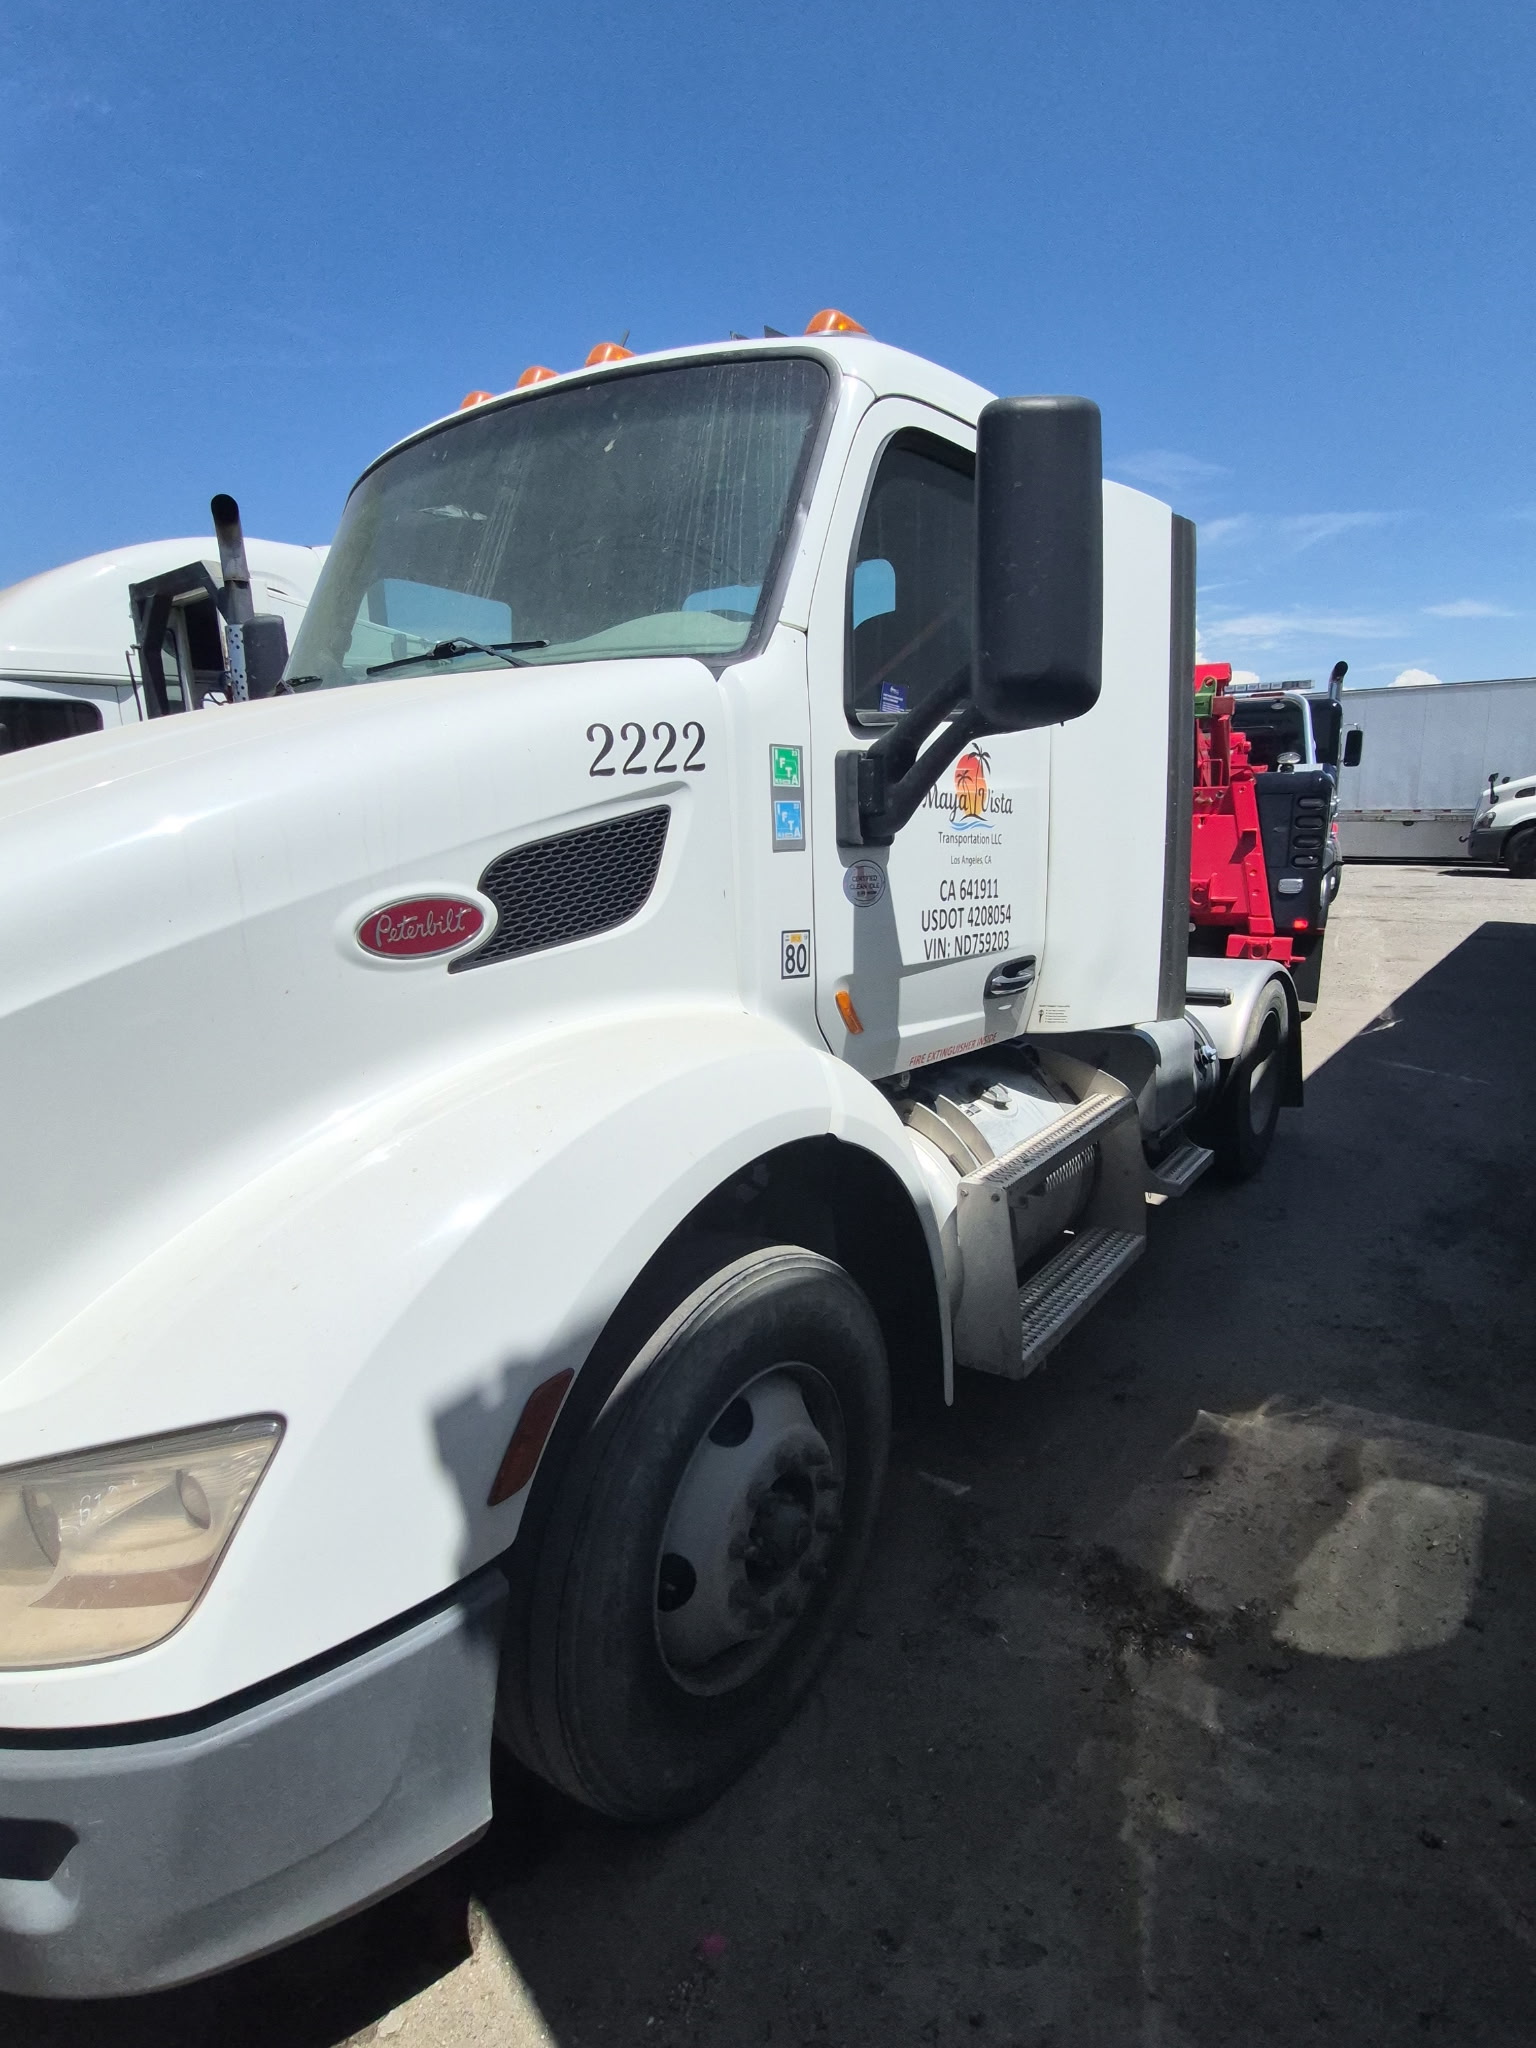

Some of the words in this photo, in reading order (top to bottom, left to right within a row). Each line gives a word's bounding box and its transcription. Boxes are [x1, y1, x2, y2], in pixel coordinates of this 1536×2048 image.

[586, 721, 706, 777] 2222
[922, 783, 968, 822] Maya
[978, 788, 1013, 814] Vista
[938, 831, 990, 847] Transportation
[991, 834, 1003, 845] LLC
[950, 855, 961, 865] Los
[961, 855, 983, 867] Angeles,
[984, 855, 992, 865] CA
[940, 879, 956, 901] CA
[960, 878, 999, 900] 641911
[374, 906, 472, 948] Peterbilt
[921, 907, 965, 932] USDOT
[967, 903, 1011, 927] 4208054
[785, 943, 807, 974] 80
[924, 937, 951, 960] VIN:
[954, 930, 1010, 957] ND759203
[909, 1053, 927, 1066] FIRE
[927, 1039, 976, 1062] EXTINGUISHER
[976, 1032, 998, 1047] INSIDE
